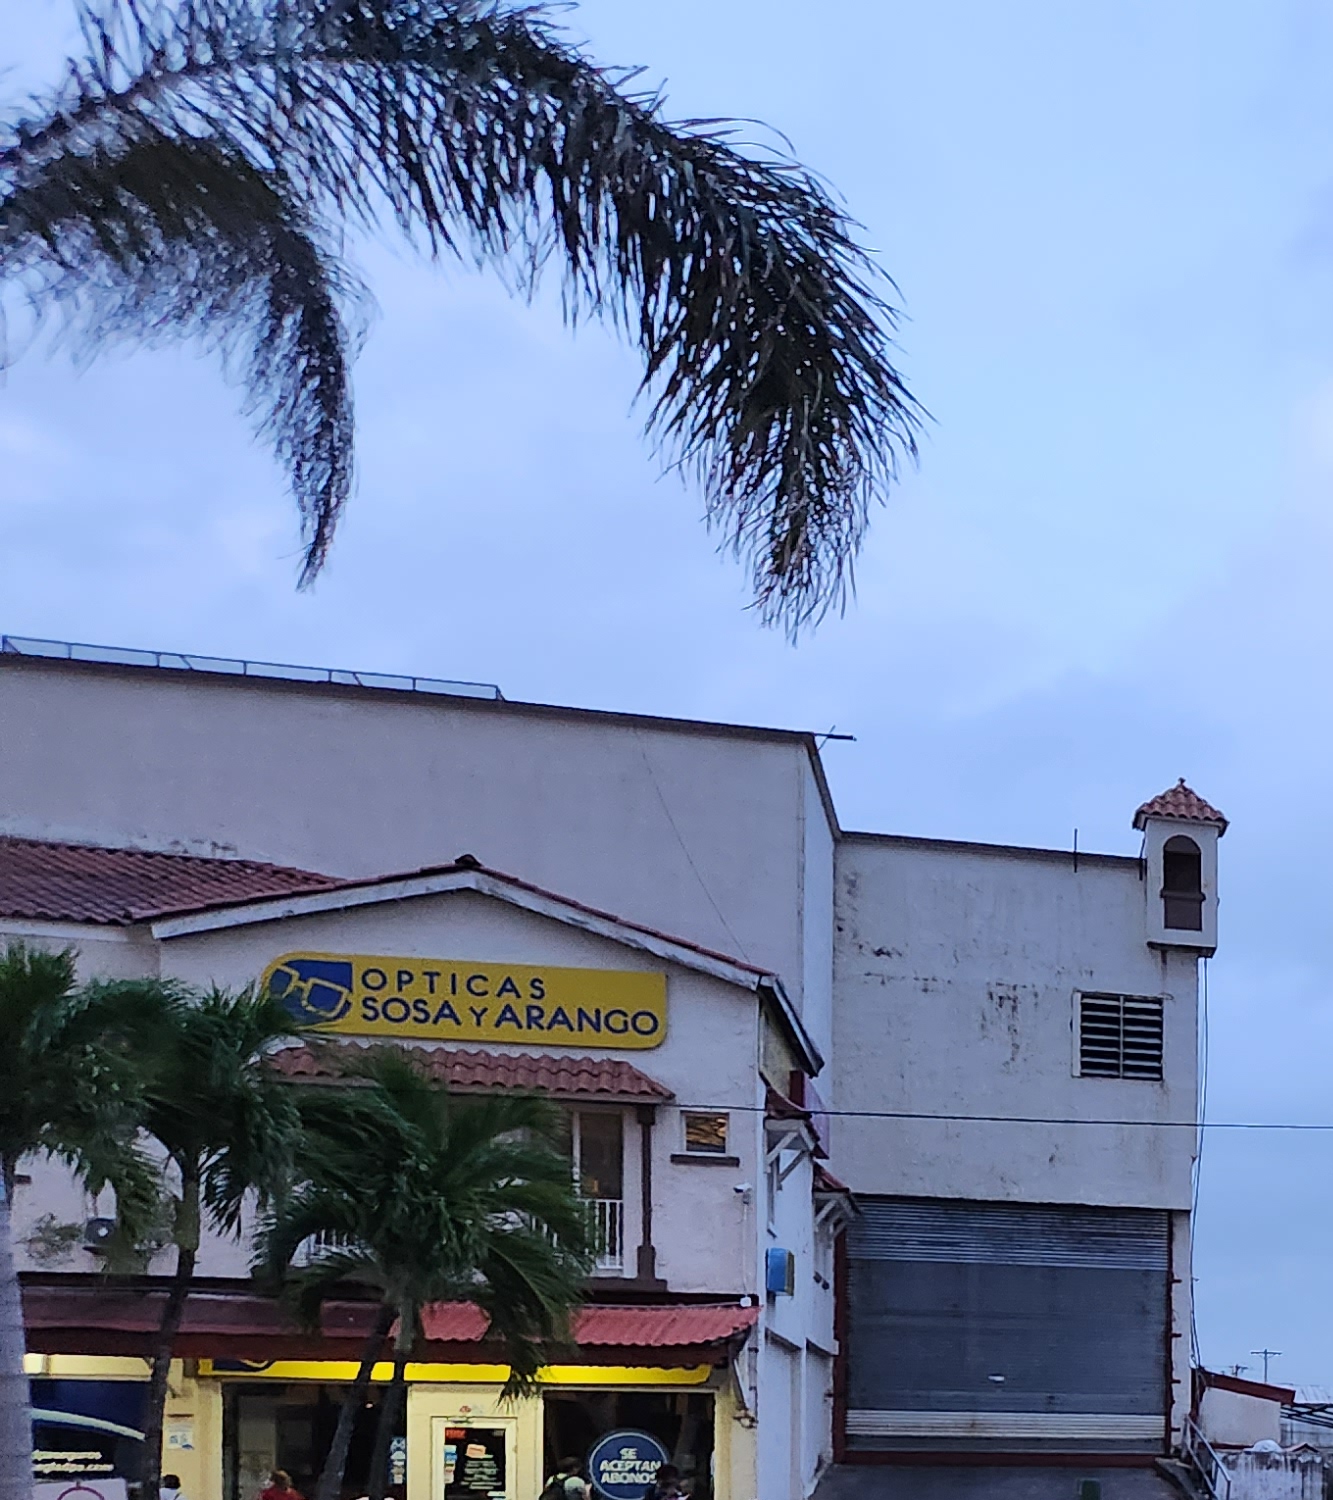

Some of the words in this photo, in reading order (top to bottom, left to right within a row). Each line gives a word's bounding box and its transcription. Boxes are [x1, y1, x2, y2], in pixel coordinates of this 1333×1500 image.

[361, 968, 544, 999] OPTICAS
[361, 997, 461, 1025] SOSA
[469, 1006, 488, 1027] Y
[495, 1004, 659, 1036] ARANGO
[620, 1448, 638, 1460] SE
[600, 1459, 661, 1472] ACEPTAN
[601, 1472, 658, 1484] ABONOS
